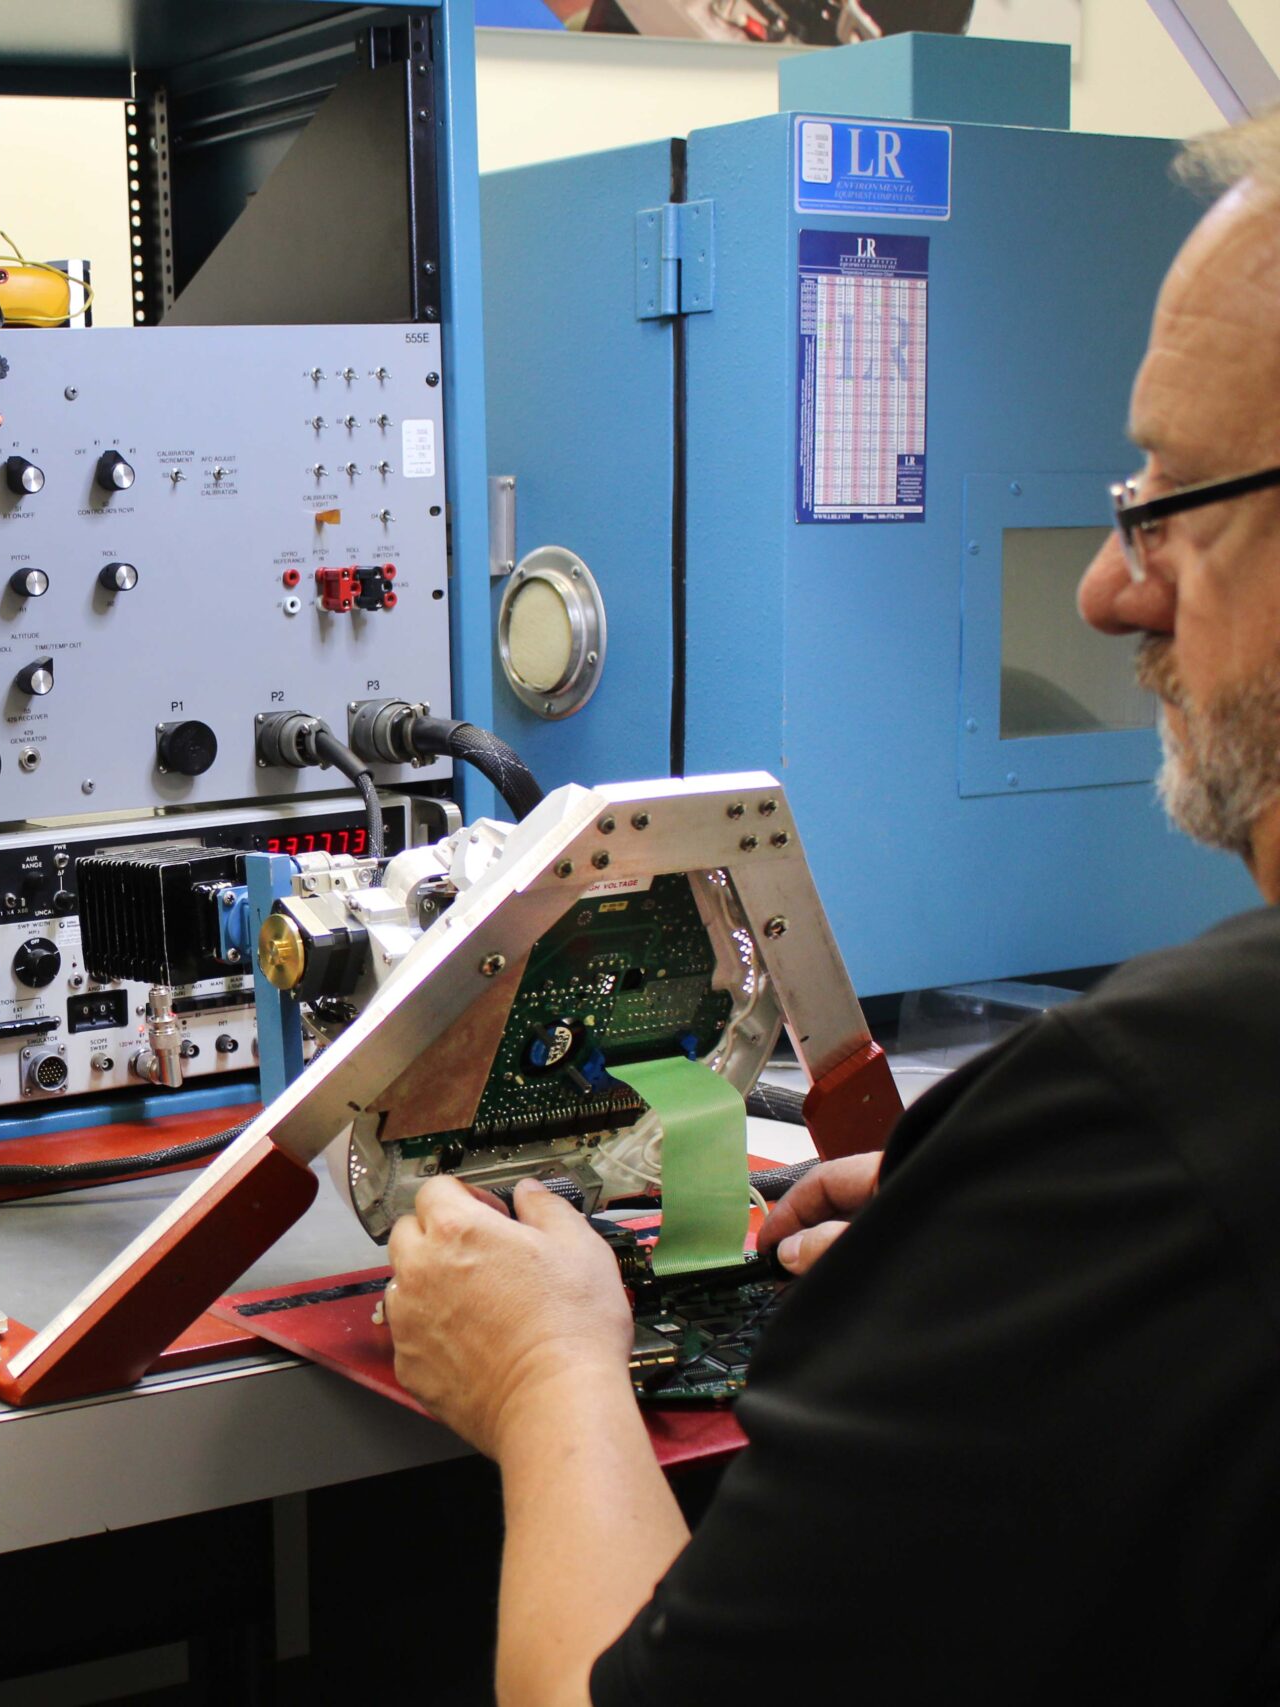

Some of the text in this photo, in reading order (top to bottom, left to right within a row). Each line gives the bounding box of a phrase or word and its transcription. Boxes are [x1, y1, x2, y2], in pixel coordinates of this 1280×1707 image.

[848, 128, 904, 178] LR
[836, 181, 916, 193] ENVIRONMENTAL
[834, 190, 872, 200] EQUIPMENT
[857, 237, 876, 257] LR
[405, 333, 430, 343] 555E
[367, 681, 381, 691] P3
[271, 691, 285, 702] P2
[170, 701, 184, 712] P1
[10, 735, 47, 744] GENERATOR
[604, 880, 638, 889] VOLTAGE
[27, 1036, 58, 1044] SIMULATOR
